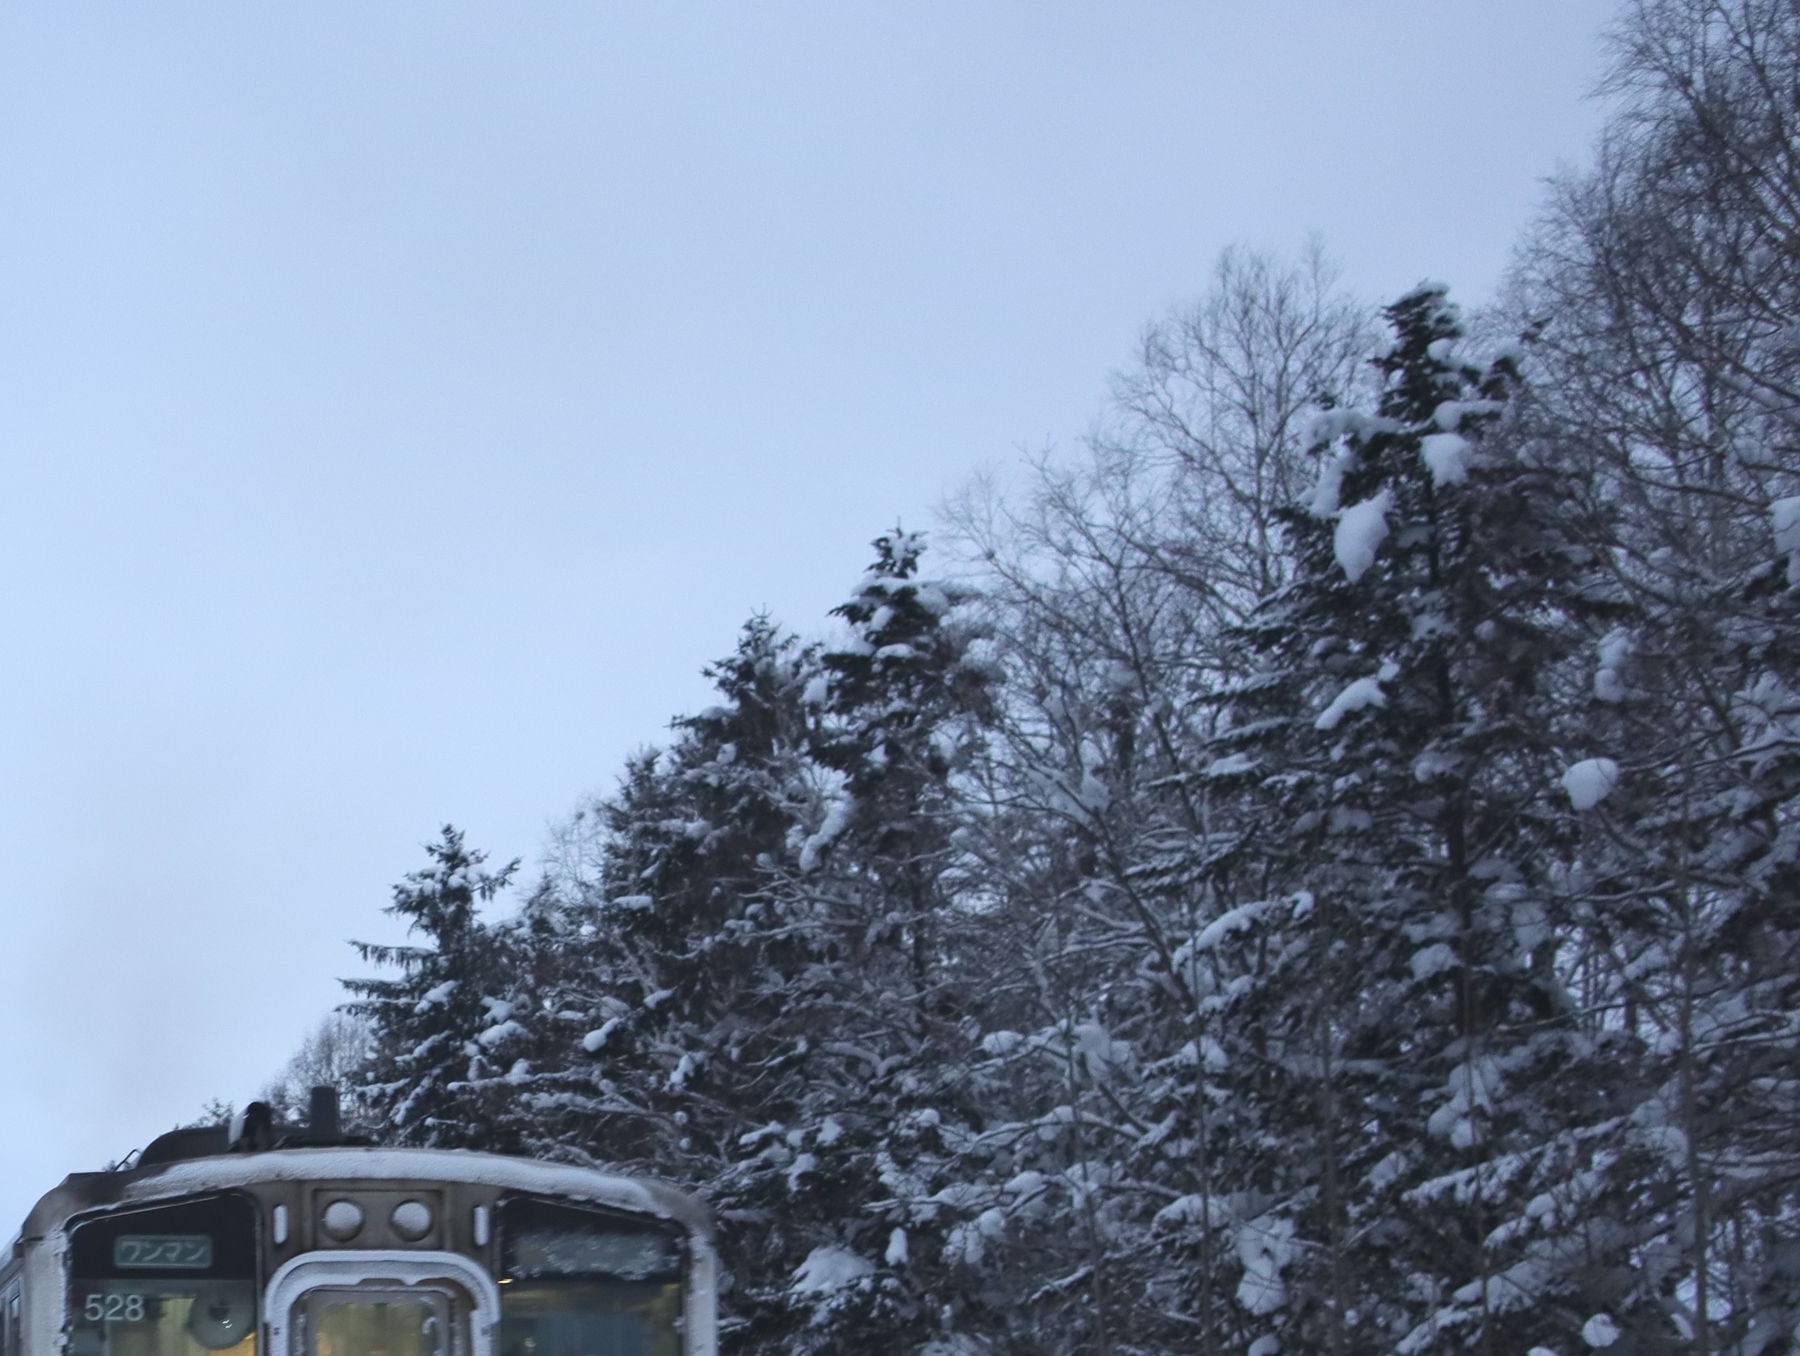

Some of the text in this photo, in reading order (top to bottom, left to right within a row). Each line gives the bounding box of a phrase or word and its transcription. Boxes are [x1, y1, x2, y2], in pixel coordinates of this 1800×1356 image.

[121, 1240, 205, 1262] ワンマン
[84, 1293, 145, 1321] 528
